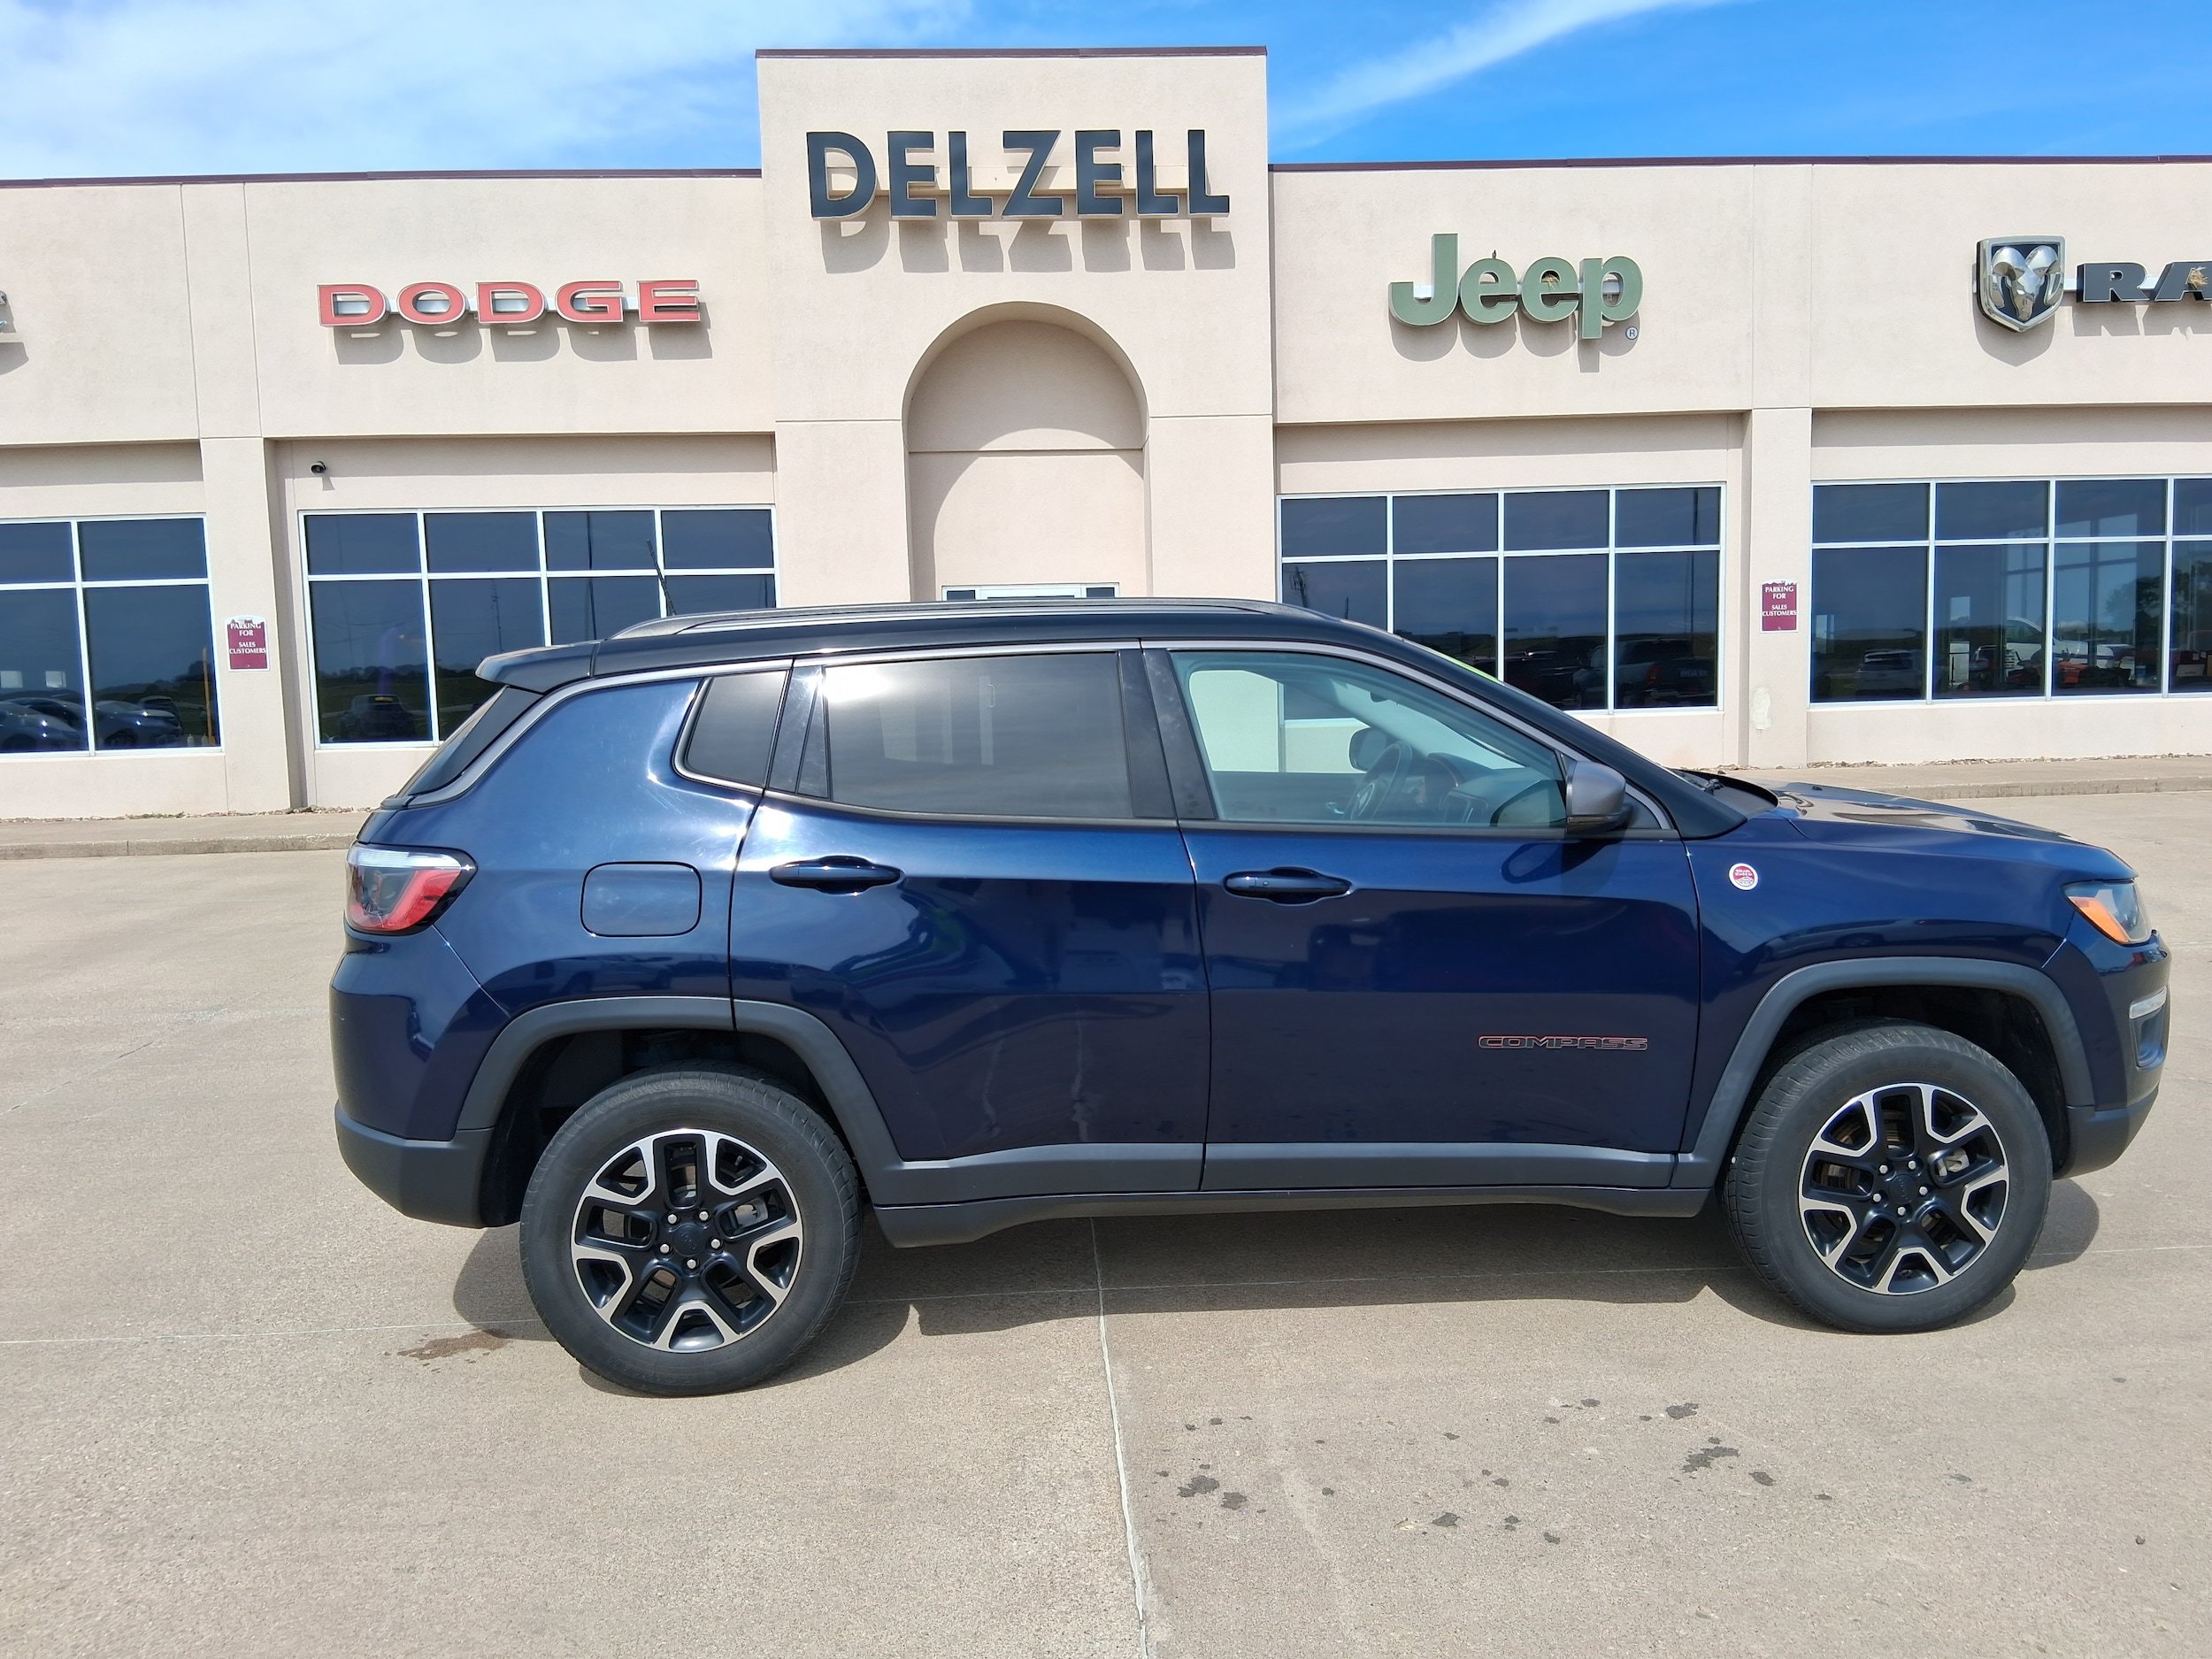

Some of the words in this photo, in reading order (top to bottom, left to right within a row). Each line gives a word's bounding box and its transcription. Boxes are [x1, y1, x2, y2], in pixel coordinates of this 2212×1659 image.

[805, 129, 1231, 220] DELZELL
[317, 280, 702, 326] DODGE
[1388, 233, 1643, 339] Jeep
[1479, 1035, 1648, 1050] COMPASS
